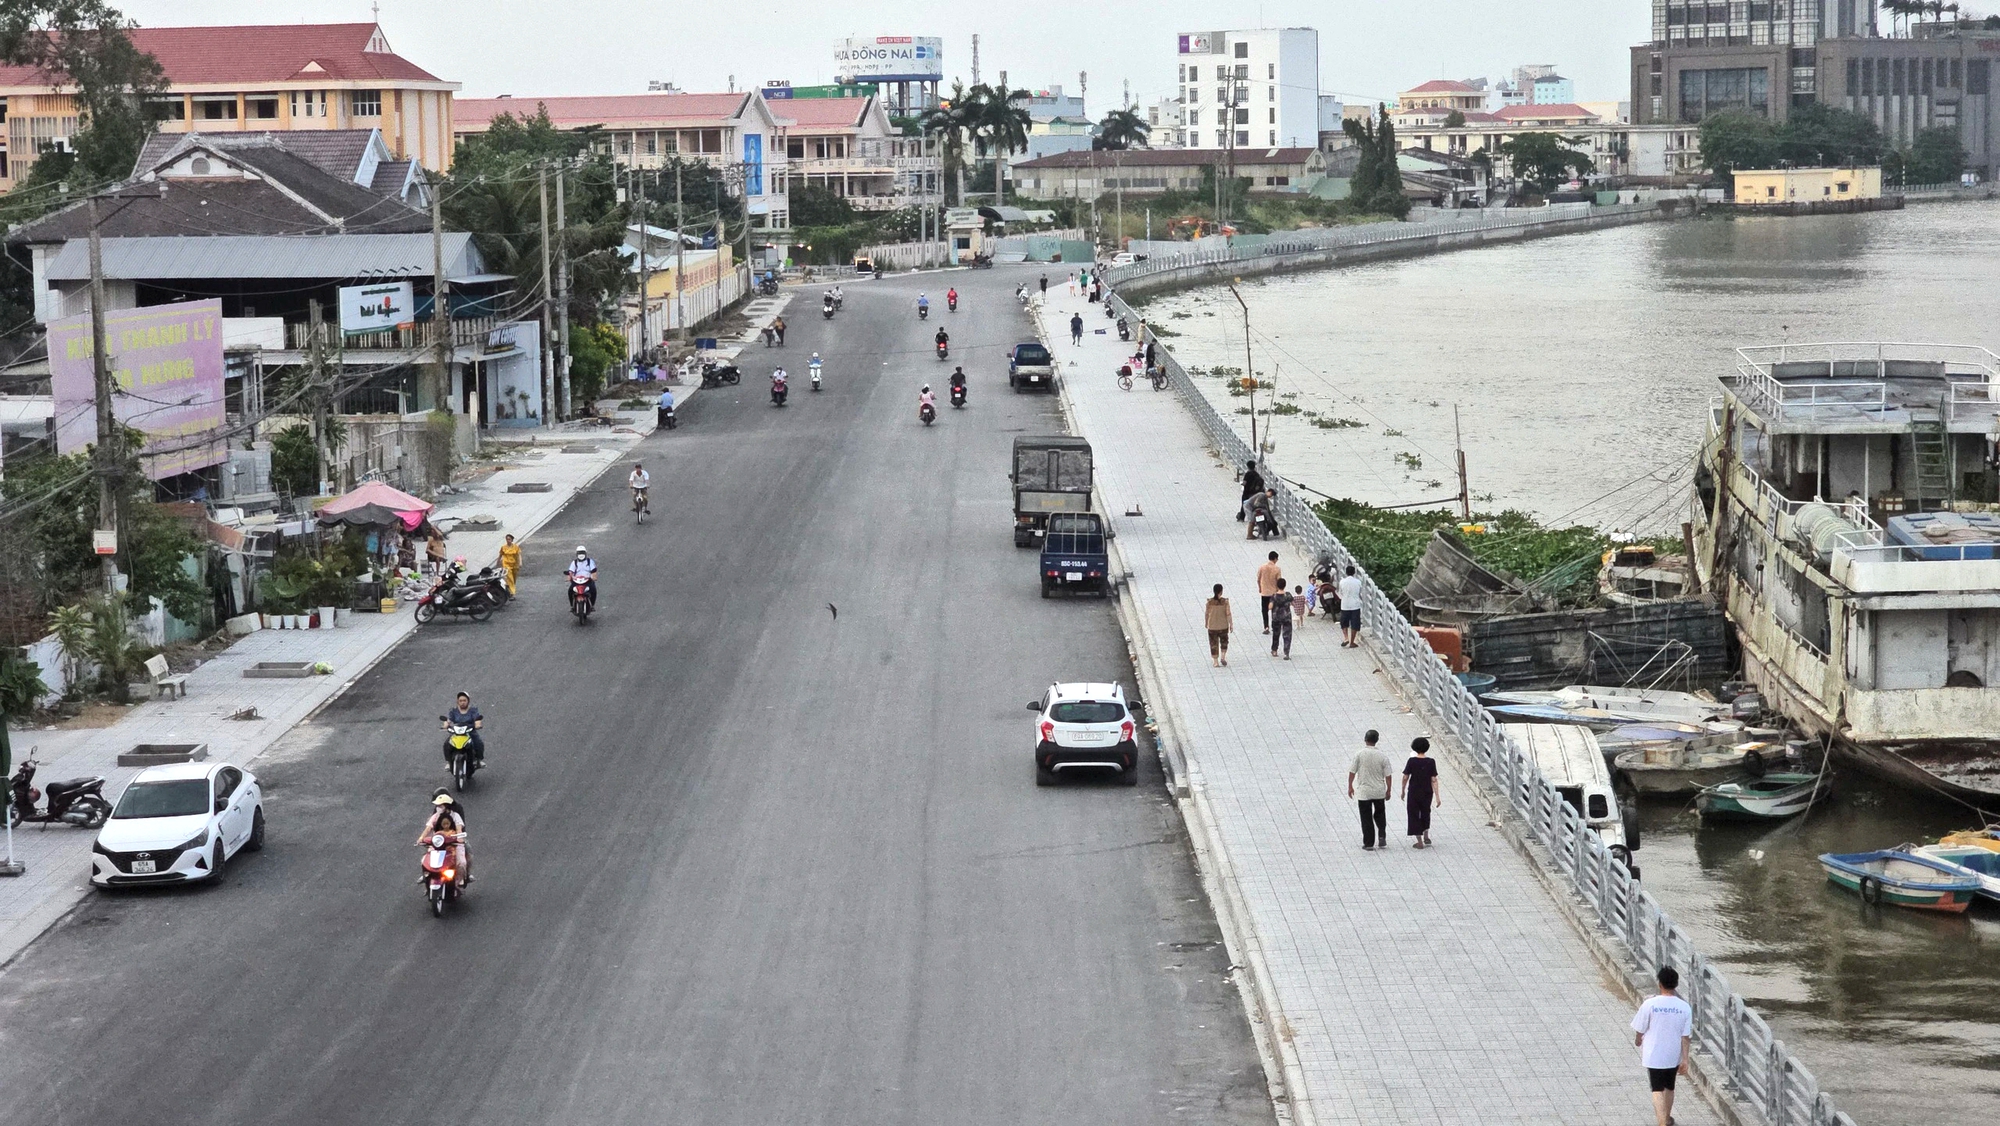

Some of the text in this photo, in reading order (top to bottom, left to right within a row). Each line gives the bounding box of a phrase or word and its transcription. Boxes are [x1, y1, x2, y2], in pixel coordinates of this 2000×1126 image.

[852, 46, 887, 60] ĐỒNG
[891, 49, 913, 59] NAI
[120, 322, 188, 351] THANH
